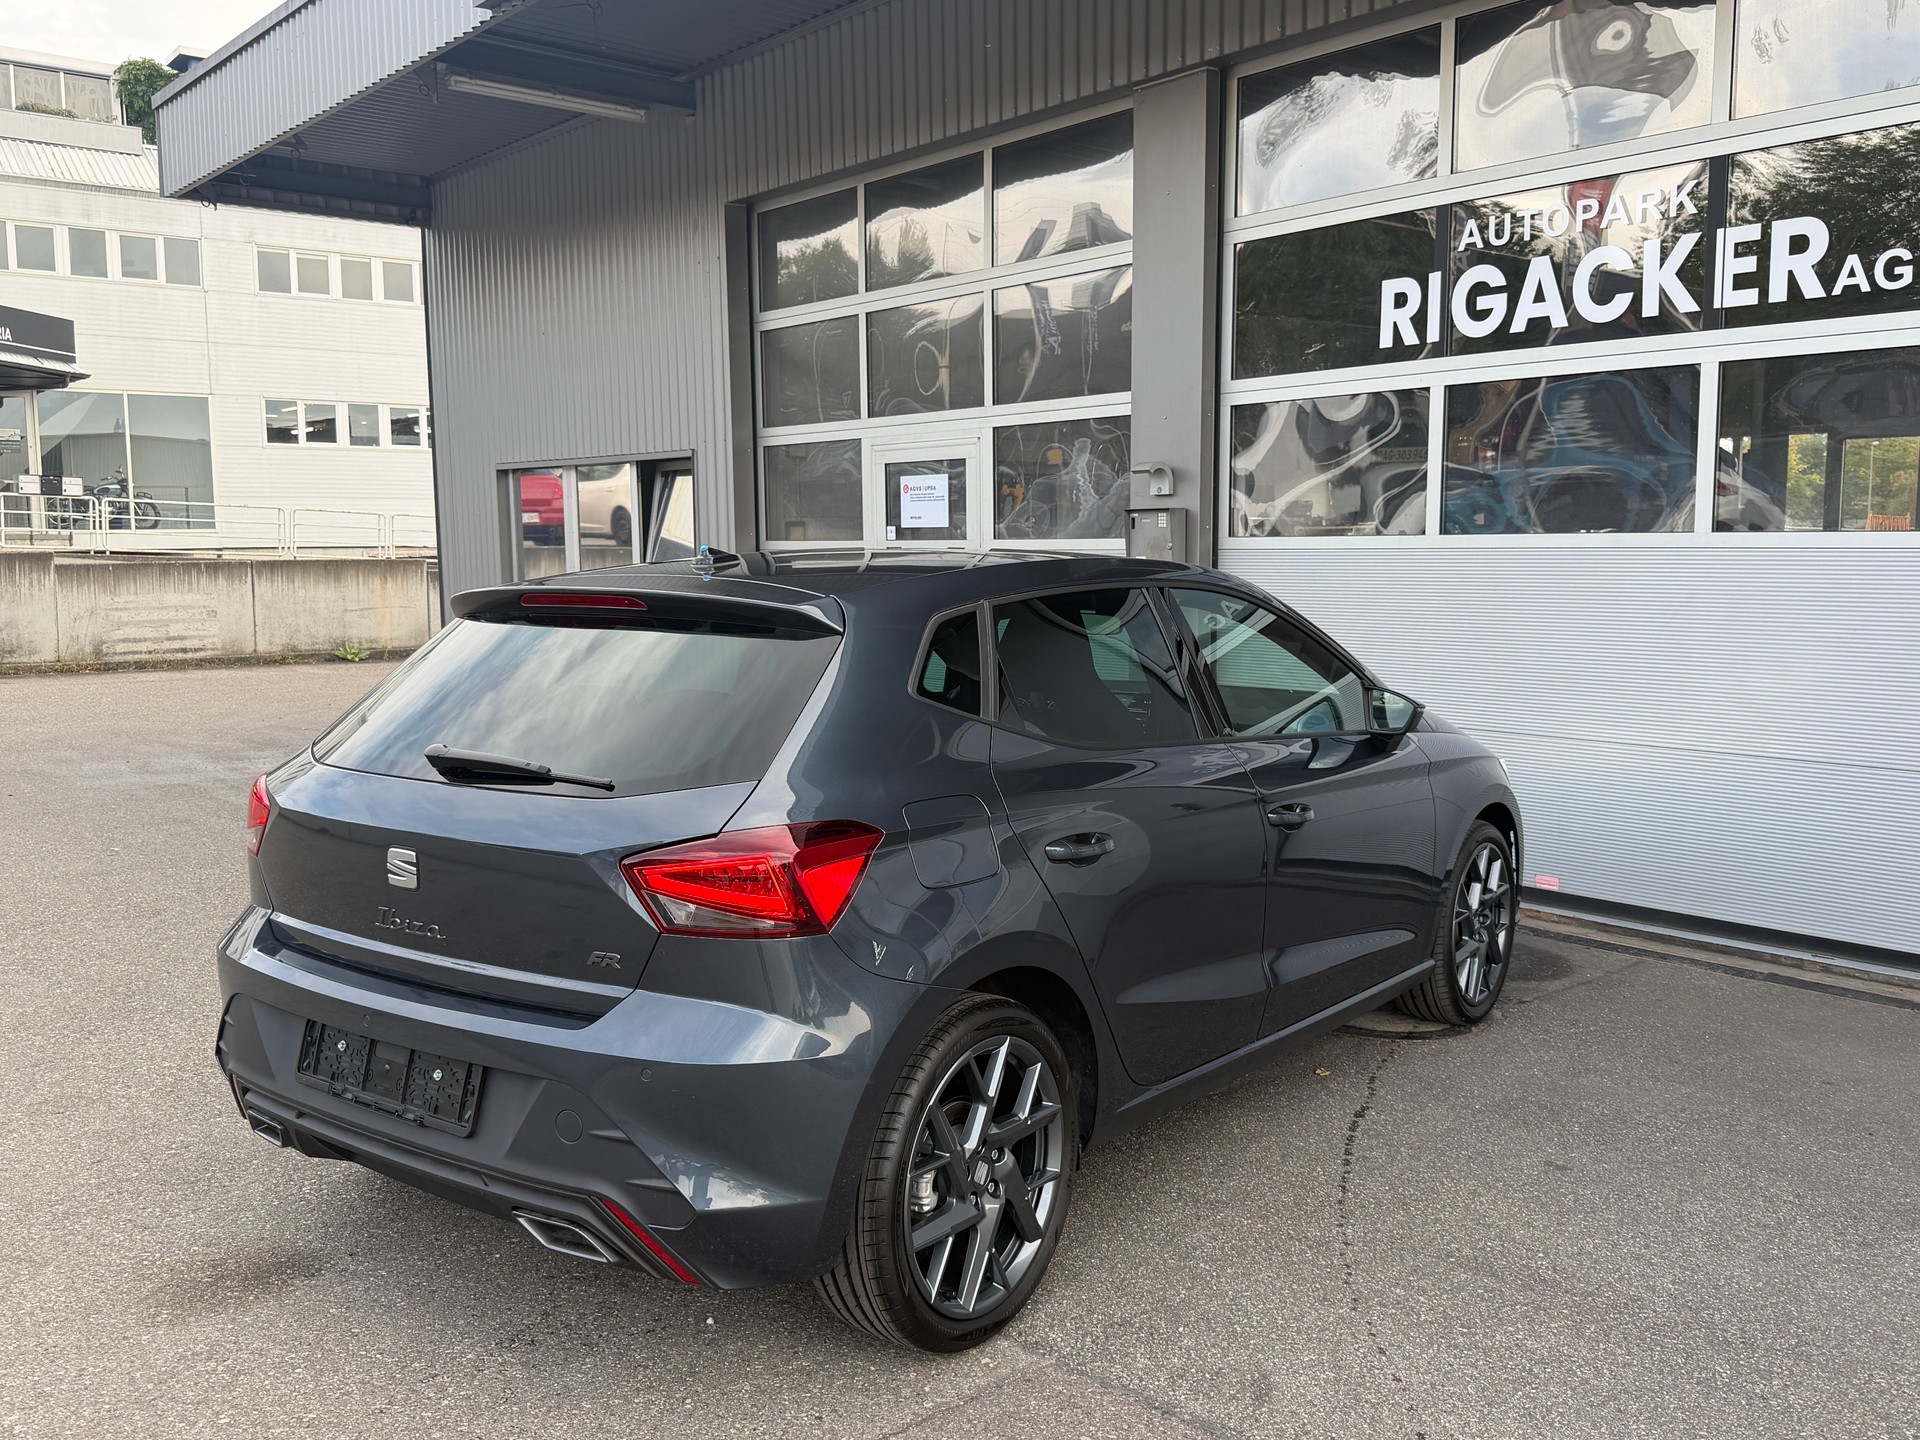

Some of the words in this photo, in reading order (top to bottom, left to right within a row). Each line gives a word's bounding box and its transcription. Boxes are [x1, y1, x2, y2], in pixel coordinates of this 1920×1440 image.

[1458, 179, 1699, 252] AUTOPARK
[1378, 216, 1829, 349] RIGACKER
[1831, 248, 1915, 296] AG
[374, 906, 447, 940] Ibiza
[586, 950, 622, 970] FR
